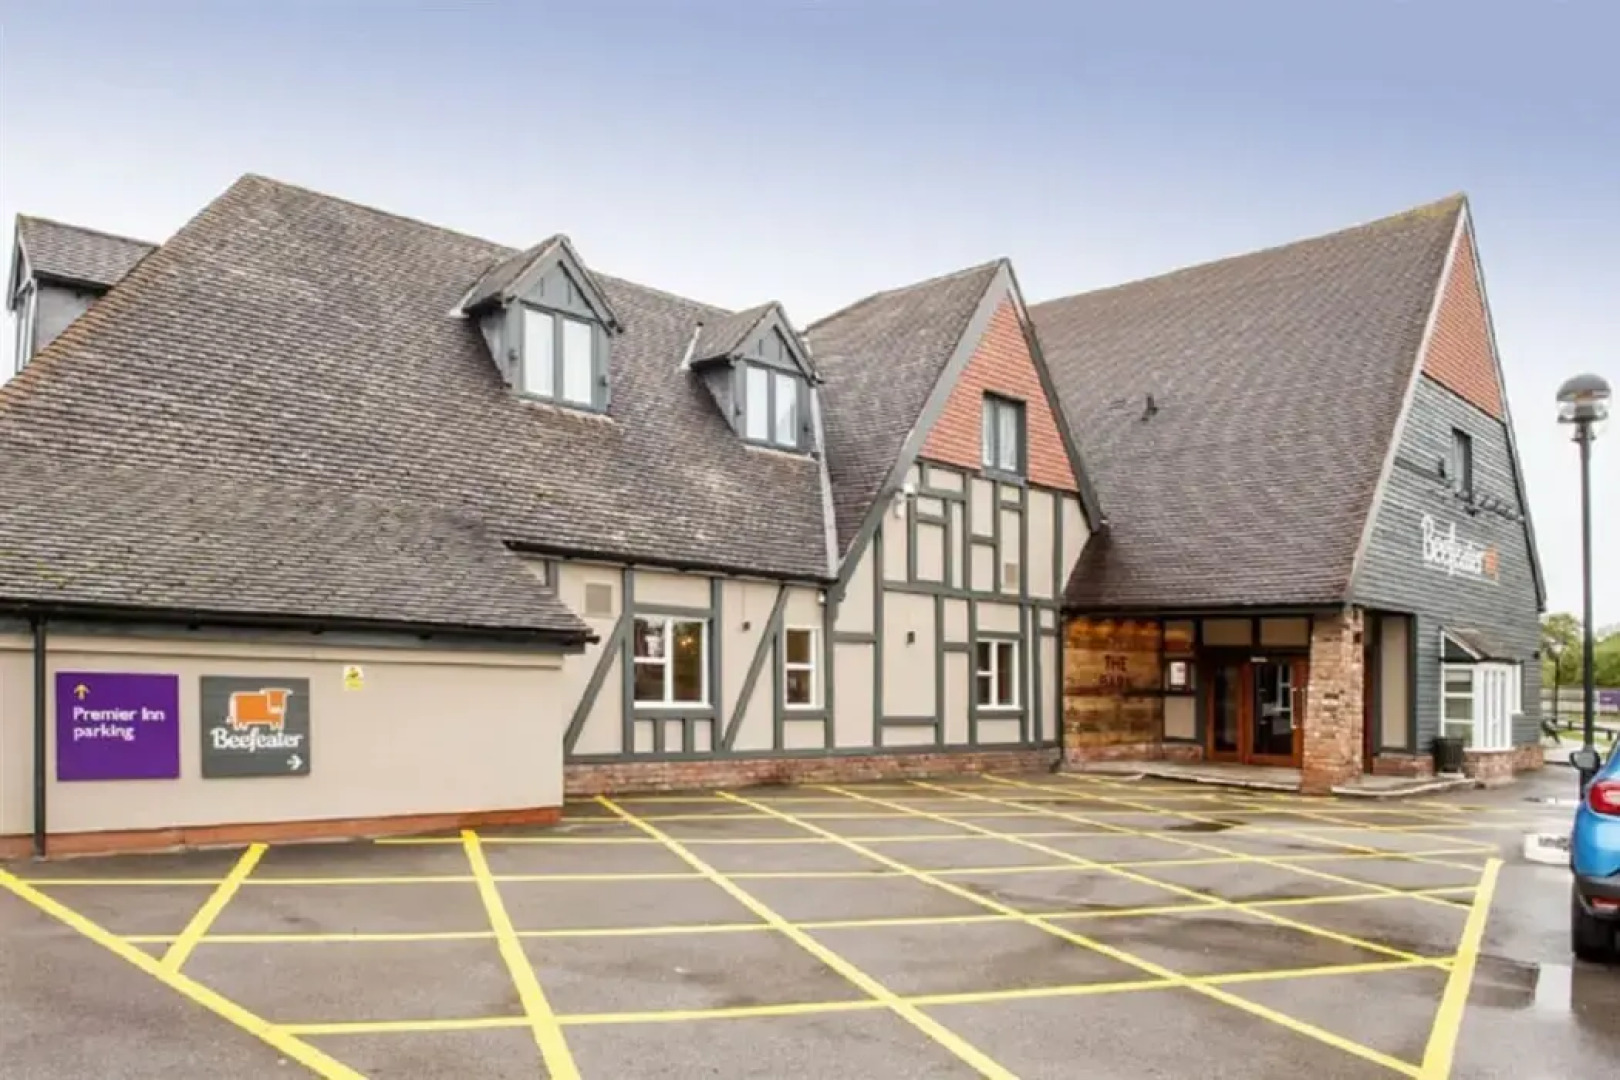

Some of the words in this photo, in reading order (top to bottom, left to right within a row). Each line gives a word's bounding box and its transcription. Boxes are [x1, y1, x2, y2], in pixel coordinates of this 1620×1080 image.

[73, 706, 138, 721] Premier
[141, 706, 165, 721] Inn
[73, 723, 135, 741] parking
[210, 726, 304, 753] Beefeater
